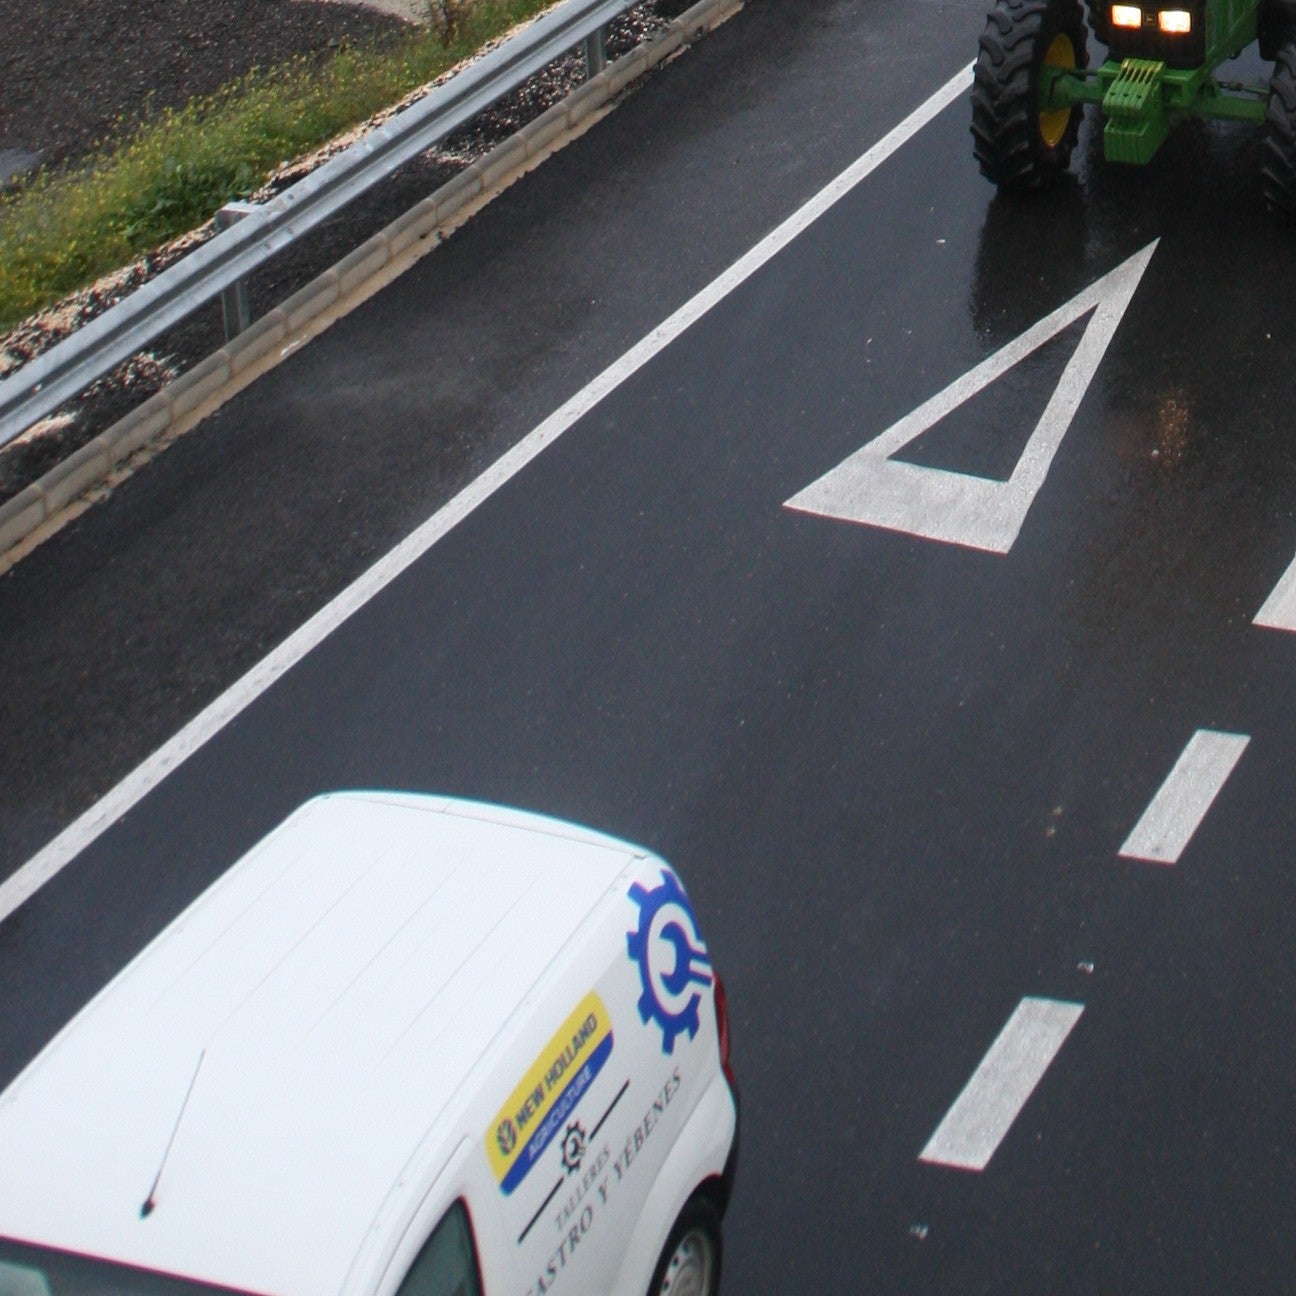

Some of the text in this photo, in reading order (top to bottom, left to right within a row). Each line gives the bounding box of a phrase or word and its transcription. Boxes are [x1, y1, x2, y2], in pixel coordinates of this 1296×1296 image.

[515, 1012, 598, 1130] NEW HOLLAND
[528, 1066, 592, 1160] AGRICULTURE
[555, 1141, 611, 1231] TALLERES
[598, 1175, 609, 1205] Y
